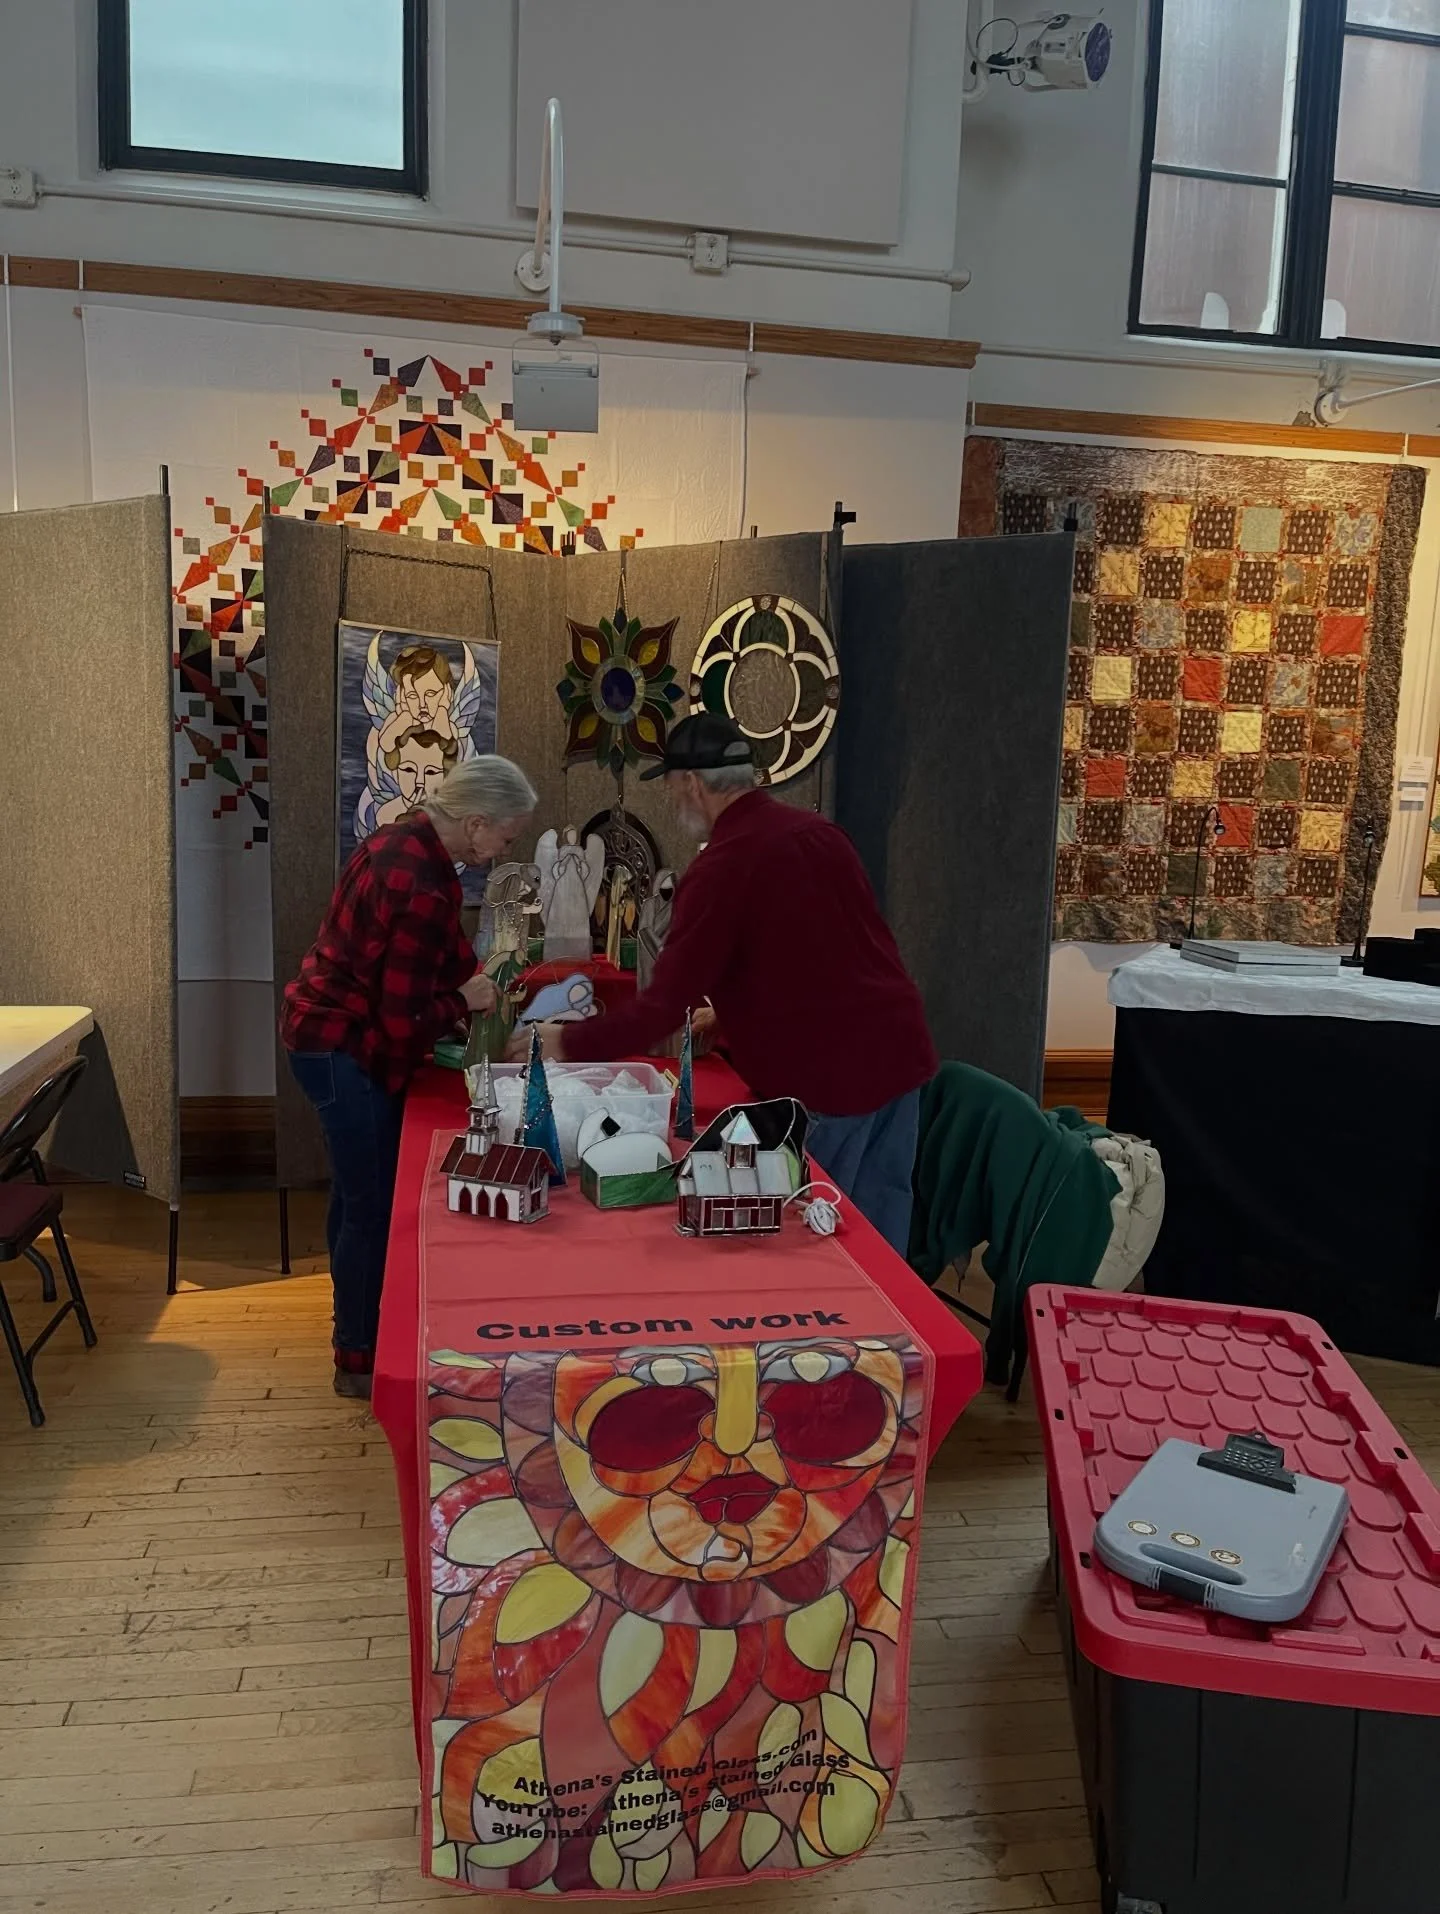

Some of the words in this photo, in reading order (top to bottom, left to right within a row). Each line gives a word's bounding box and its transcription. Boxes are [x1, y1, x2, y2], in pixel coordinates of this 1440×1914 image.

[477, 1317, 693, 1340] Custom
[710, 1310, 850, 1330] work
[481, 1793, 588, 1819] YouTube:
[603, 1785, 699, 1811] Athena's
[706, 1761, 784, 1790] Stained
[789, 1750, 850, 1769] Glass
[514, 1774, 613, 1797] Athena's
[620, 1762, 707, 1785] Stained
[491, 1779, 835, 1839] athenastainedglass@gmail.com
